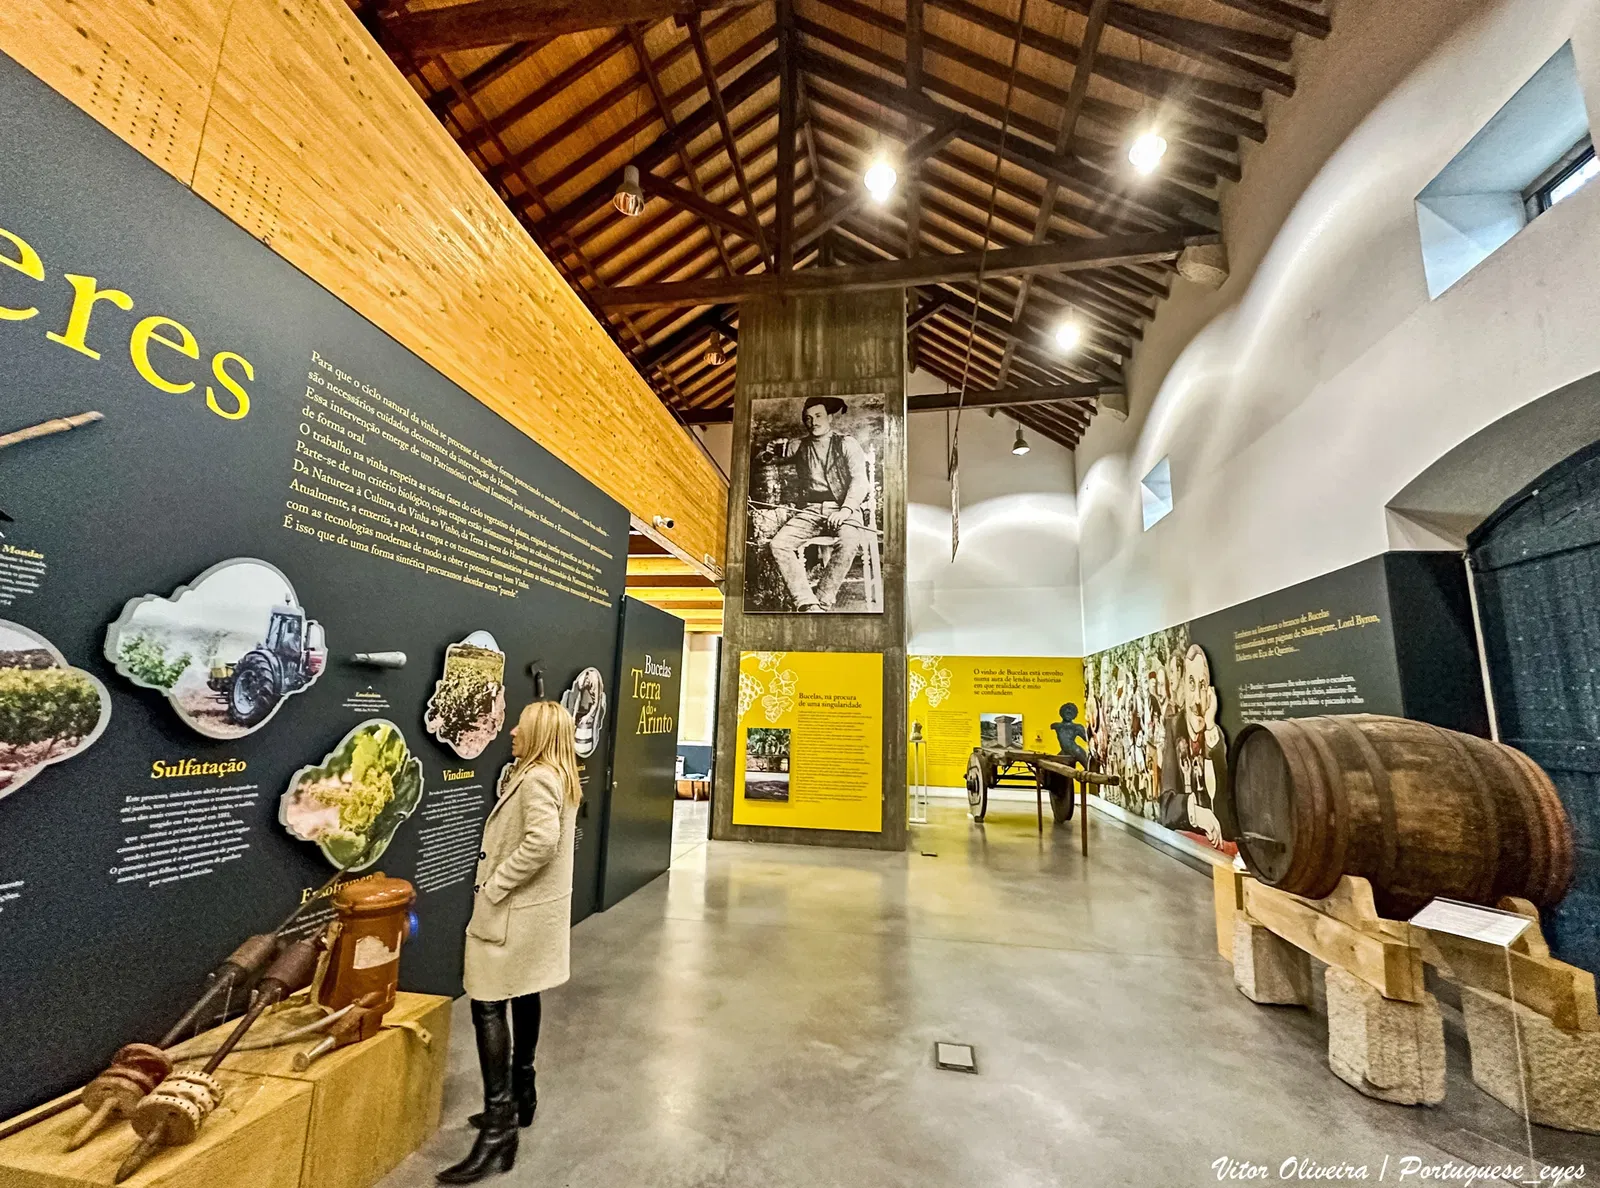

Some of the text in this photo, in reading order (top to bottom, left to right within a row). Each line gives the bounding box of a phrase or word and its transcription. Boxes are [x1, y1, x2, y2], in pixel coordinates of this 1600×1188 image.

[302, 405, 366, 445] de forma oral.
[308, 372, 325, 385] são
[326, 382, 375, 414] necessários
[376, 411, 410, 434] cuidados
[410, 428, 448, 456] decorrentes
[448, 450, 457, 462] da
[457, 455, 489, 479] intervenção
[489, 474, 497, 484] do
[311, 350, 333, 372] Para
[335, 369, 352, 384] que
[361, 384, 382, 400] ciclo
[382, 397, 410, 418] natural
[410, 412, 419, 424] da
[420, 420, 439, 436] vinha
[440, 432, 447, 440] se
[447, 436, 472, 455] processe
[472, 450, 480, 460] da
[305, 385, 328, 407] Essa
[330, 400, 380, 434] intervenção
[381, 431, 409, 451] emerge
[410, 444, 420, 456] de
[420, 451, 432, 463] um
[433, 456, 467, 481] Património
[296, 440, 482, 531] Parte-se de um critério biológico, cujas etapas estão
[299, 423, 310, 435] O
[313, 431, 352, 455] trabalho
[353, 451, 364, 462] na
[366, 456, 388, 473] vinha
[389, 469, 418, 487] respeita
[418, 482, 426, 491] as
[427, 486, 446, 500] várias
[446, 493, 461, 507] fases
[461, 501, 470, 511] do
[470, 506, 484, 518] ciclo
[286, 500, 309, 514] com
[311, 509, 322, 518] as
[324, 512, 374, 536] tecnologias
[375, 531, 412, 549] modernas
[412, 541, 422, 553] de
[422, 548, 442, 559] modo
[447, 555, 464, 567] obter
[289, 478, 350, 511] Atualmente,
[351, 505, 357, 513] a
[358, 508, 393, 527] enxertia,
[399, 523, 420, 537] poda,
[425, 533, 444, 546] empa
[293, 458, 309, 475] Da
[312, 466, 354, 494] Natureza
[356, 486, 362, 496] à
[364, 488, 396, 512] Cultura,
[397, 503, 407, 515] da
[409, 506, 430, 524] Vinha
[430, 519, 439, 527] ao
[440, 520, 460, 538] Vinho,
[460, 530, 468, 540] da
[469, 532, 484, 546] Terra
[502, 547, 509, 556] do
[283, 514, 293, 529] É
[295, 520, 315, 535] isso
[317, 530, 335, 542] que
[336, 533, 348, 546] de
[350, 540, 369, 552] uma
[370, 544, 394, 560] forma
[396, 553, 425, 570] sintética
[425, 564, 462, 581] procuramos
[1308, 609, 1330, 622] Bucelas
[1337, 616, 1355, 629] Lord
[1355, 615, 1380, 627] Byron,
[631, 667, 660, 700] Terra
[644, 654, 672, 678] Bucelas
[636, 705, 672, 734] Arinto
[646, 700, 654, 715] do
[150, 758, 247, 779] Sulfatação
[442, 768, 475, 781] Vindima
